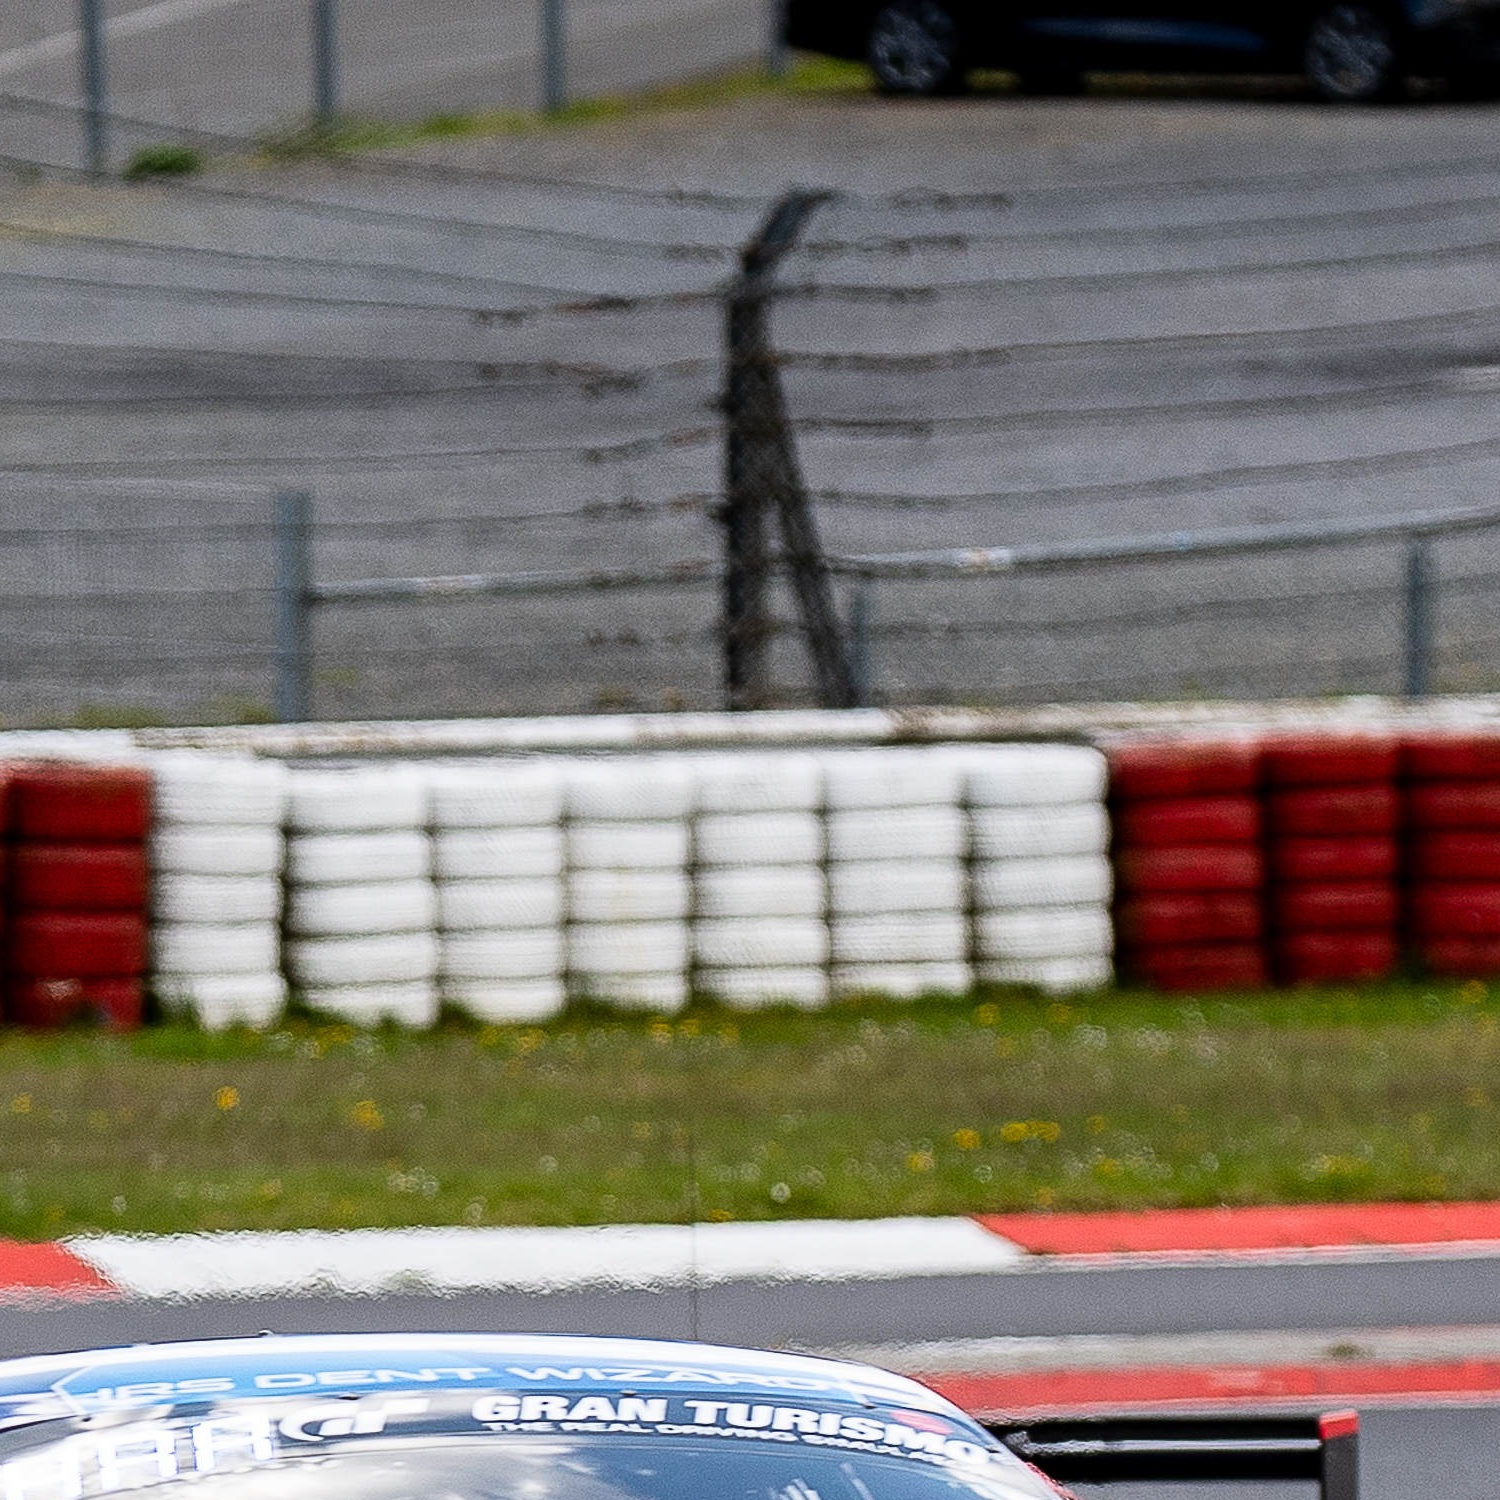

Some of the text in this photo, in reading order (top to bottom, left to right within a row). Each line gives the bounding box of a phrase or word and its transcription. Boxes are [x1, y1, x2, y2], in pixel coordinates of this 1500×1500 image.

[253, 1366, 491, 1390] DENT
[505, 1366, 835, 1392] WIZARD
[470, 1394, 993, 1466] GRAN TURISMO
[482, 1421, 554, 1433] THE
[558, 1421, 653, 1433] REAL
